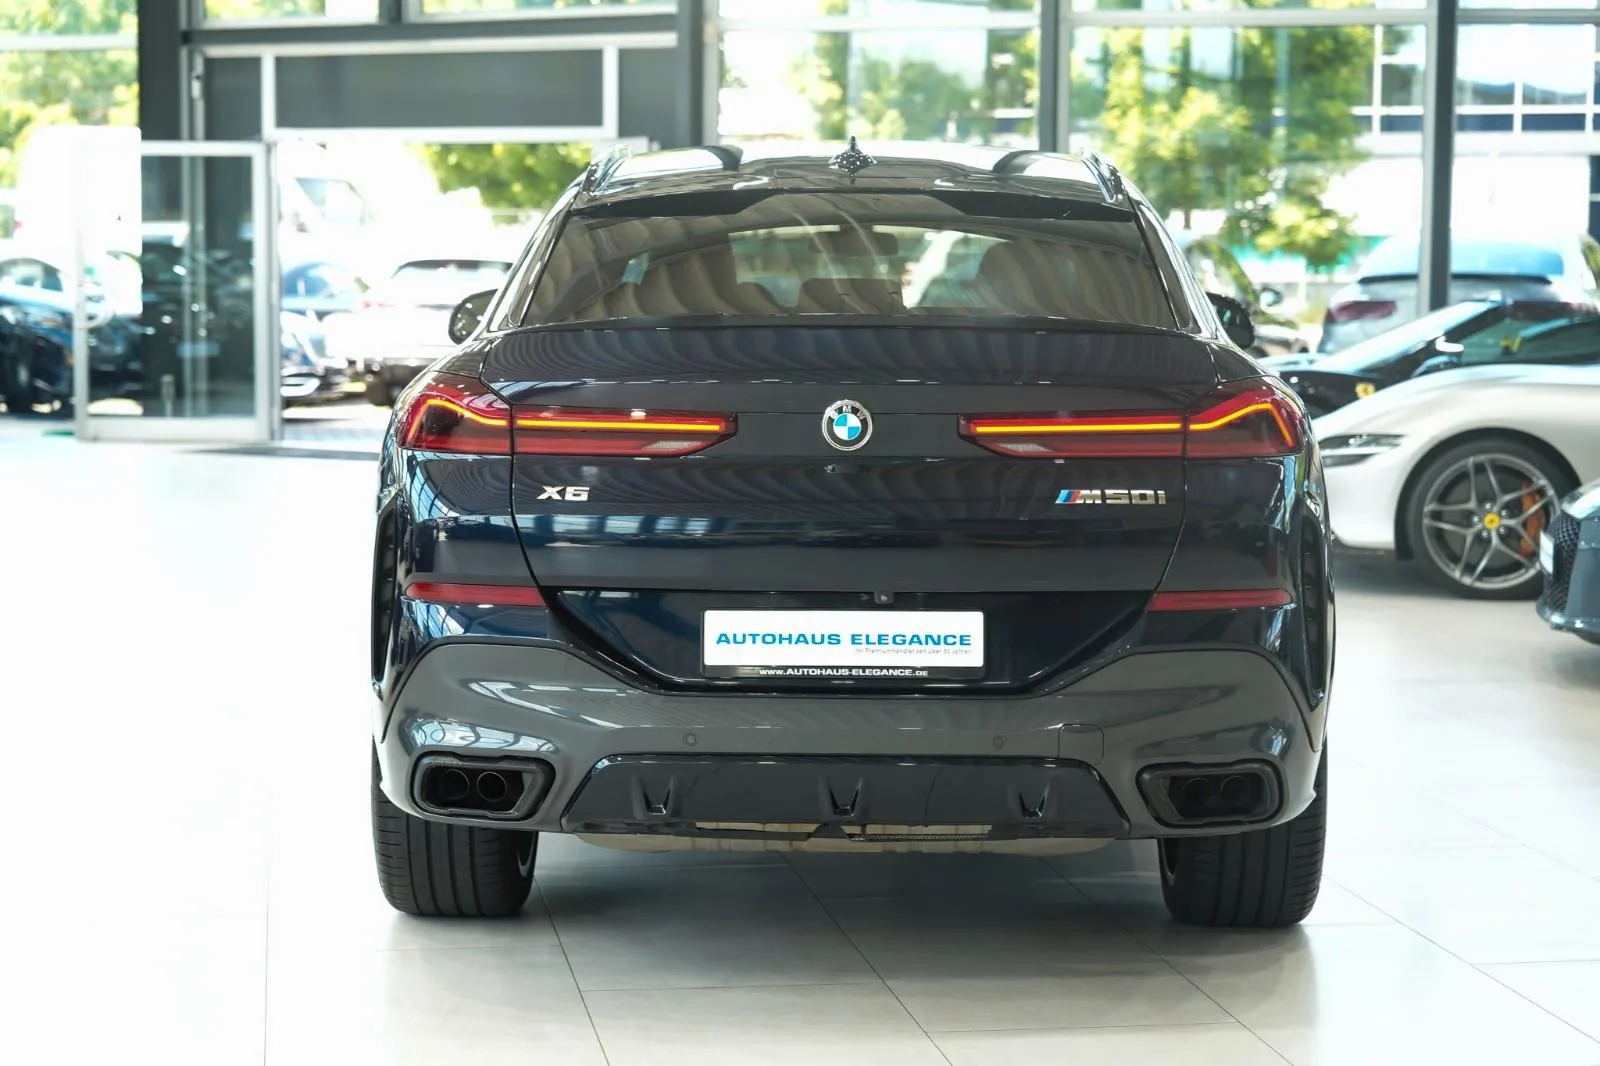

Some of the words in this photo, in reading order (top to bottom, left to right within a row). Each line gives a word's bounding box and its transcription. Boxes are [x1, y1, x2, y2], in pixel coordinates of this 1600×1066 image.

[536, 485, 590, 501] X6
[716, 633, 842, 645] AUTOHAUS
[850, 634, 972, 646] ELEGANCE
